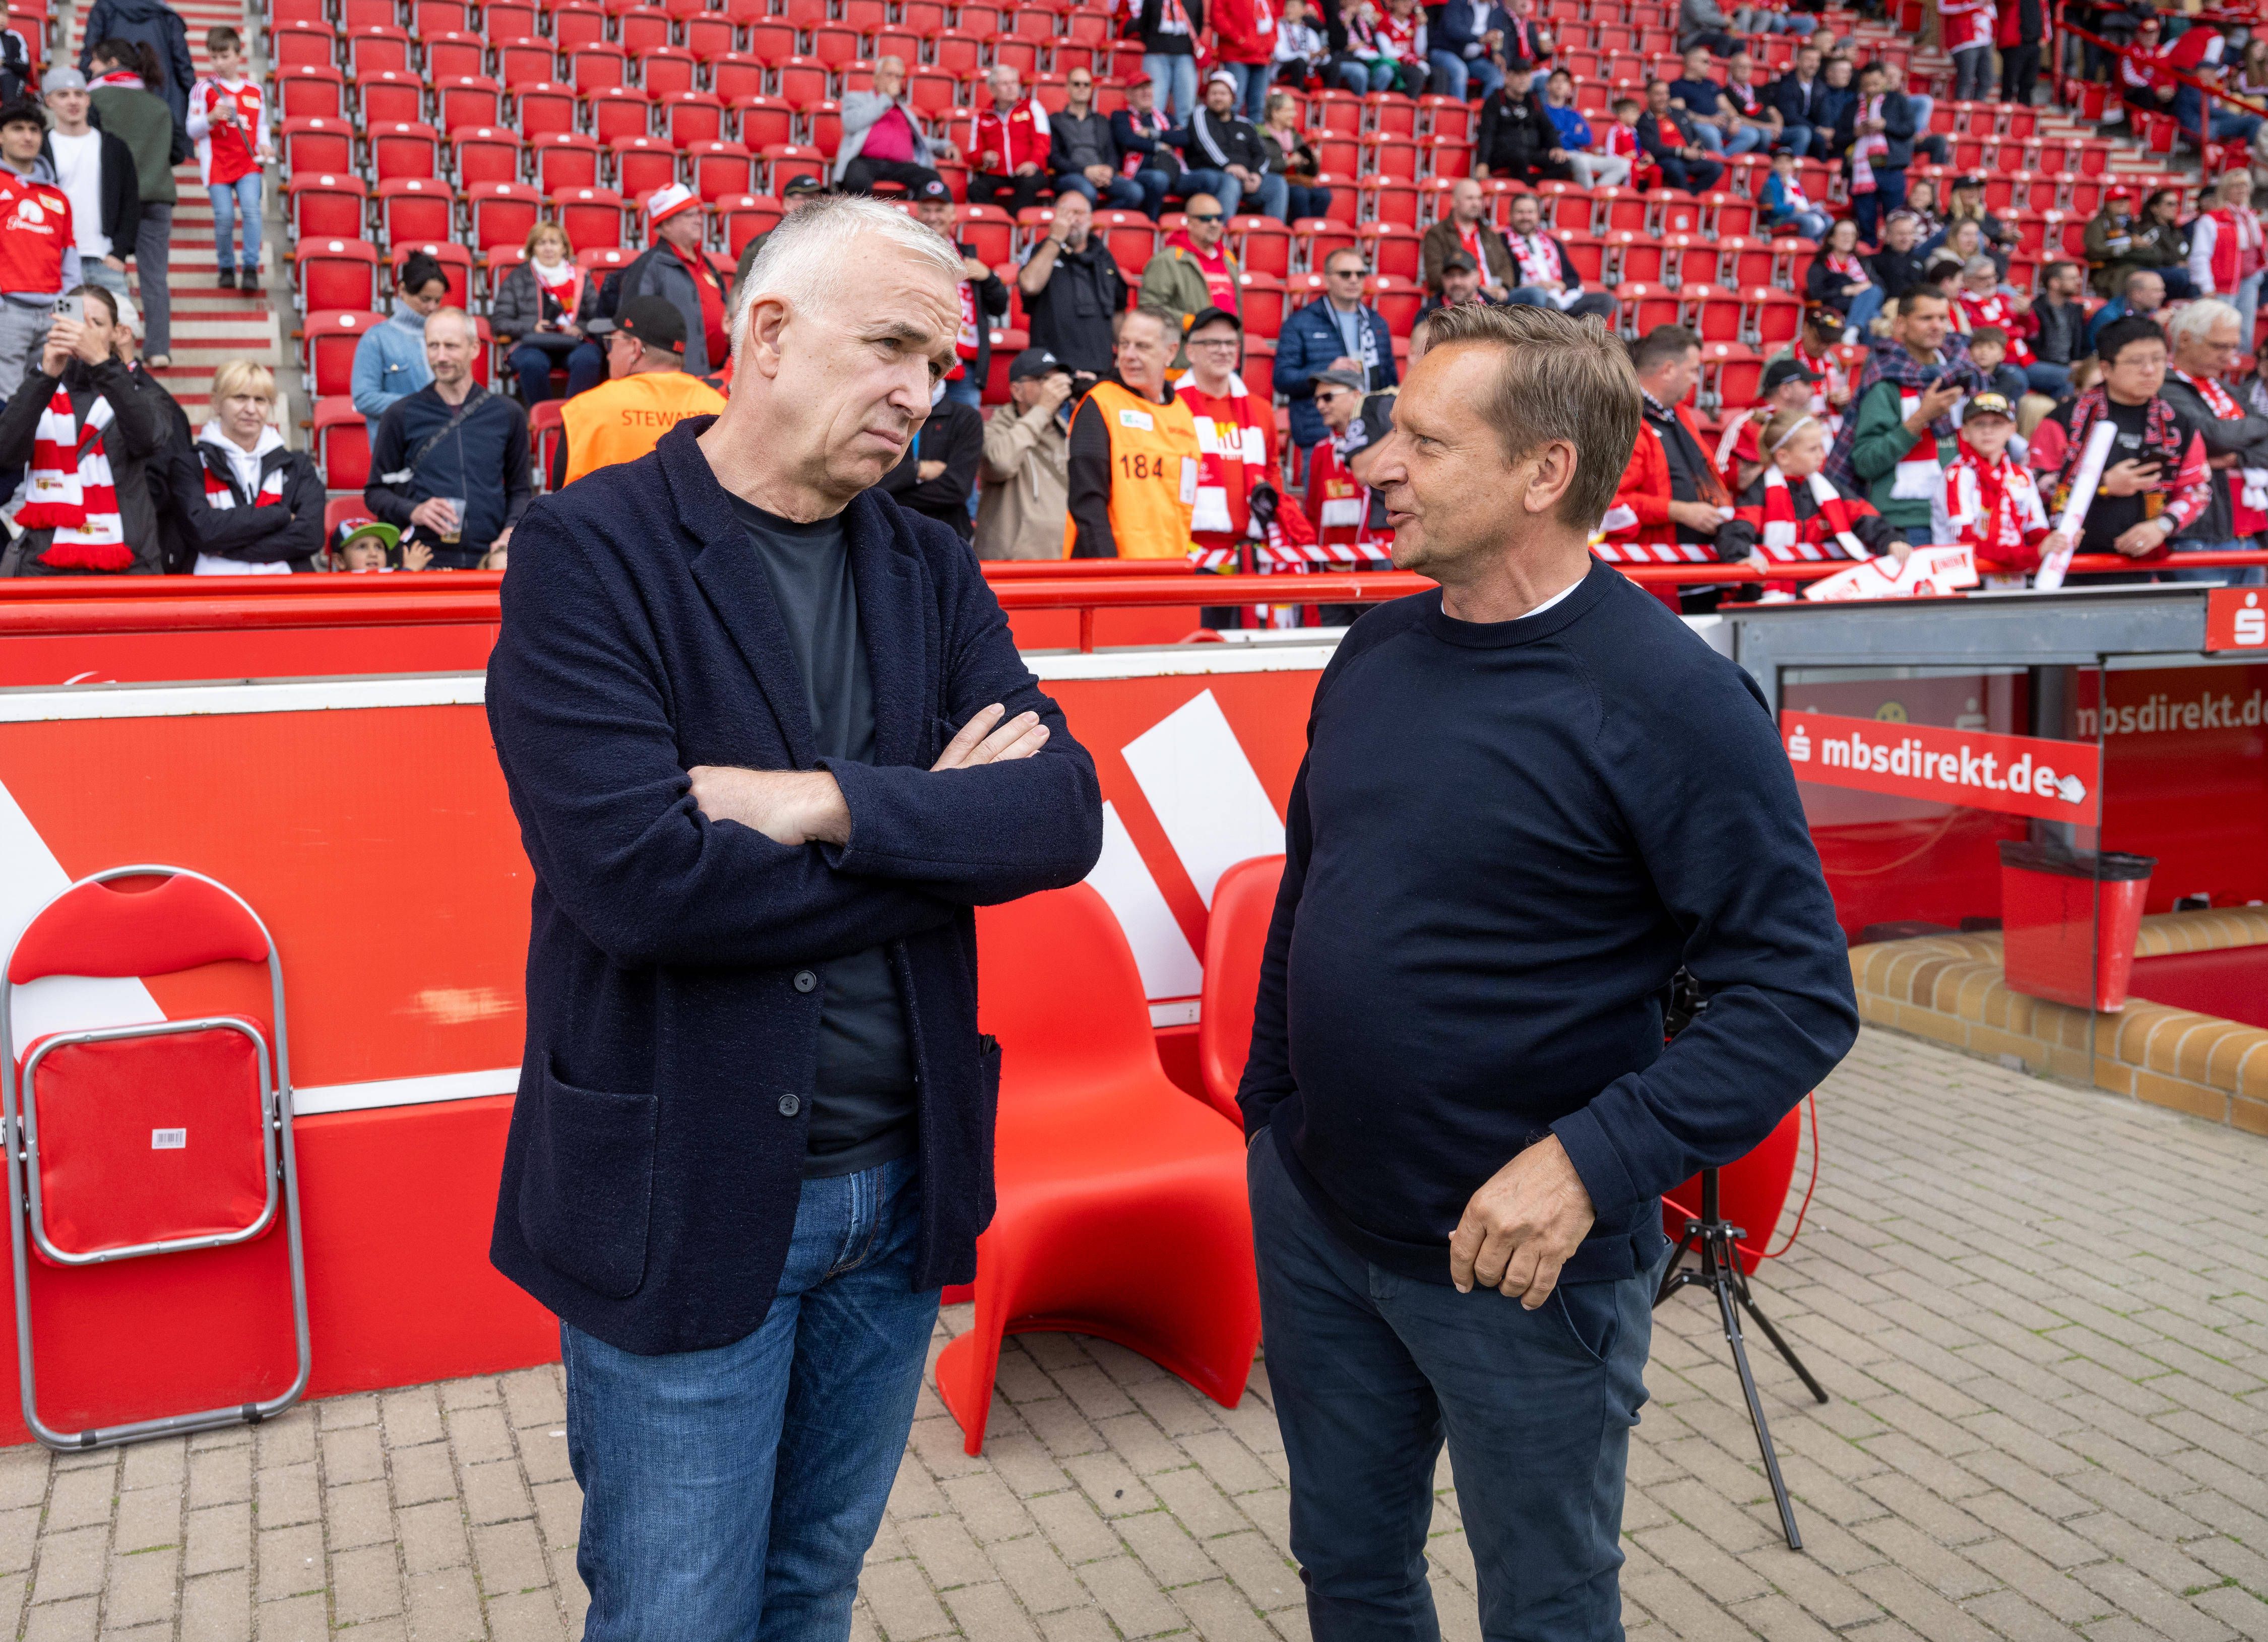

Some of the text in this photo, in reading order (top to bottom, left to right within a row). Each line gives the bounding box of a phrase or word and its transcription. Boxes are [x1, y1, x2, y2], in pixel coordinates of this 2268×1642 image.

[621, 409, 710, 427] STEWA
[1120, 454, 1163, 479] 184
[1821, 732, 2056, 797] mbsdirekt.de
